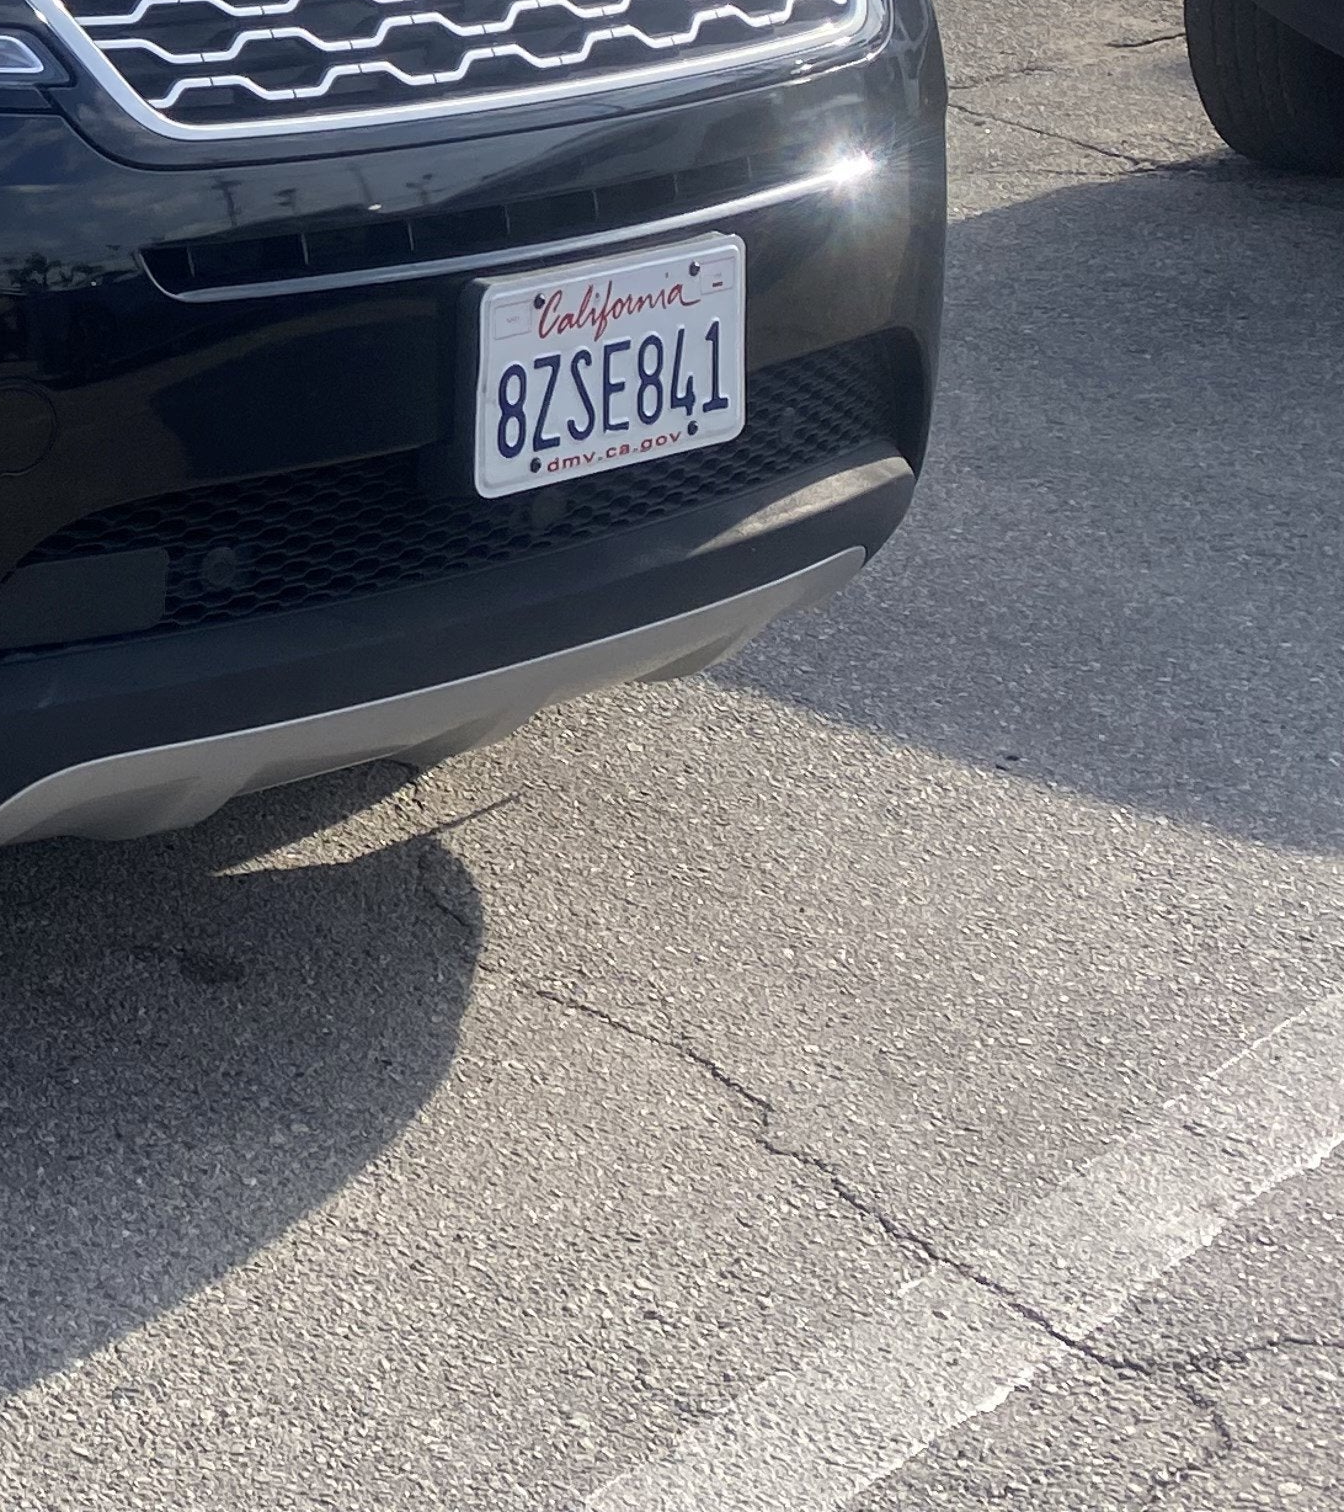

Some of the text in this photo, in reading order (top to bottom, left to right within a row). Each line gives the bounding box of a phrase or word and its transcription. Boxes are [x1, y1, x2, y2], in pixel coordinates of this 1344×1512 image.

[537, 281, 700, 341] California
[496, 320, 729, 458] 8ZSE841
[547, 431, 682, 473] dmv.ca.gov
